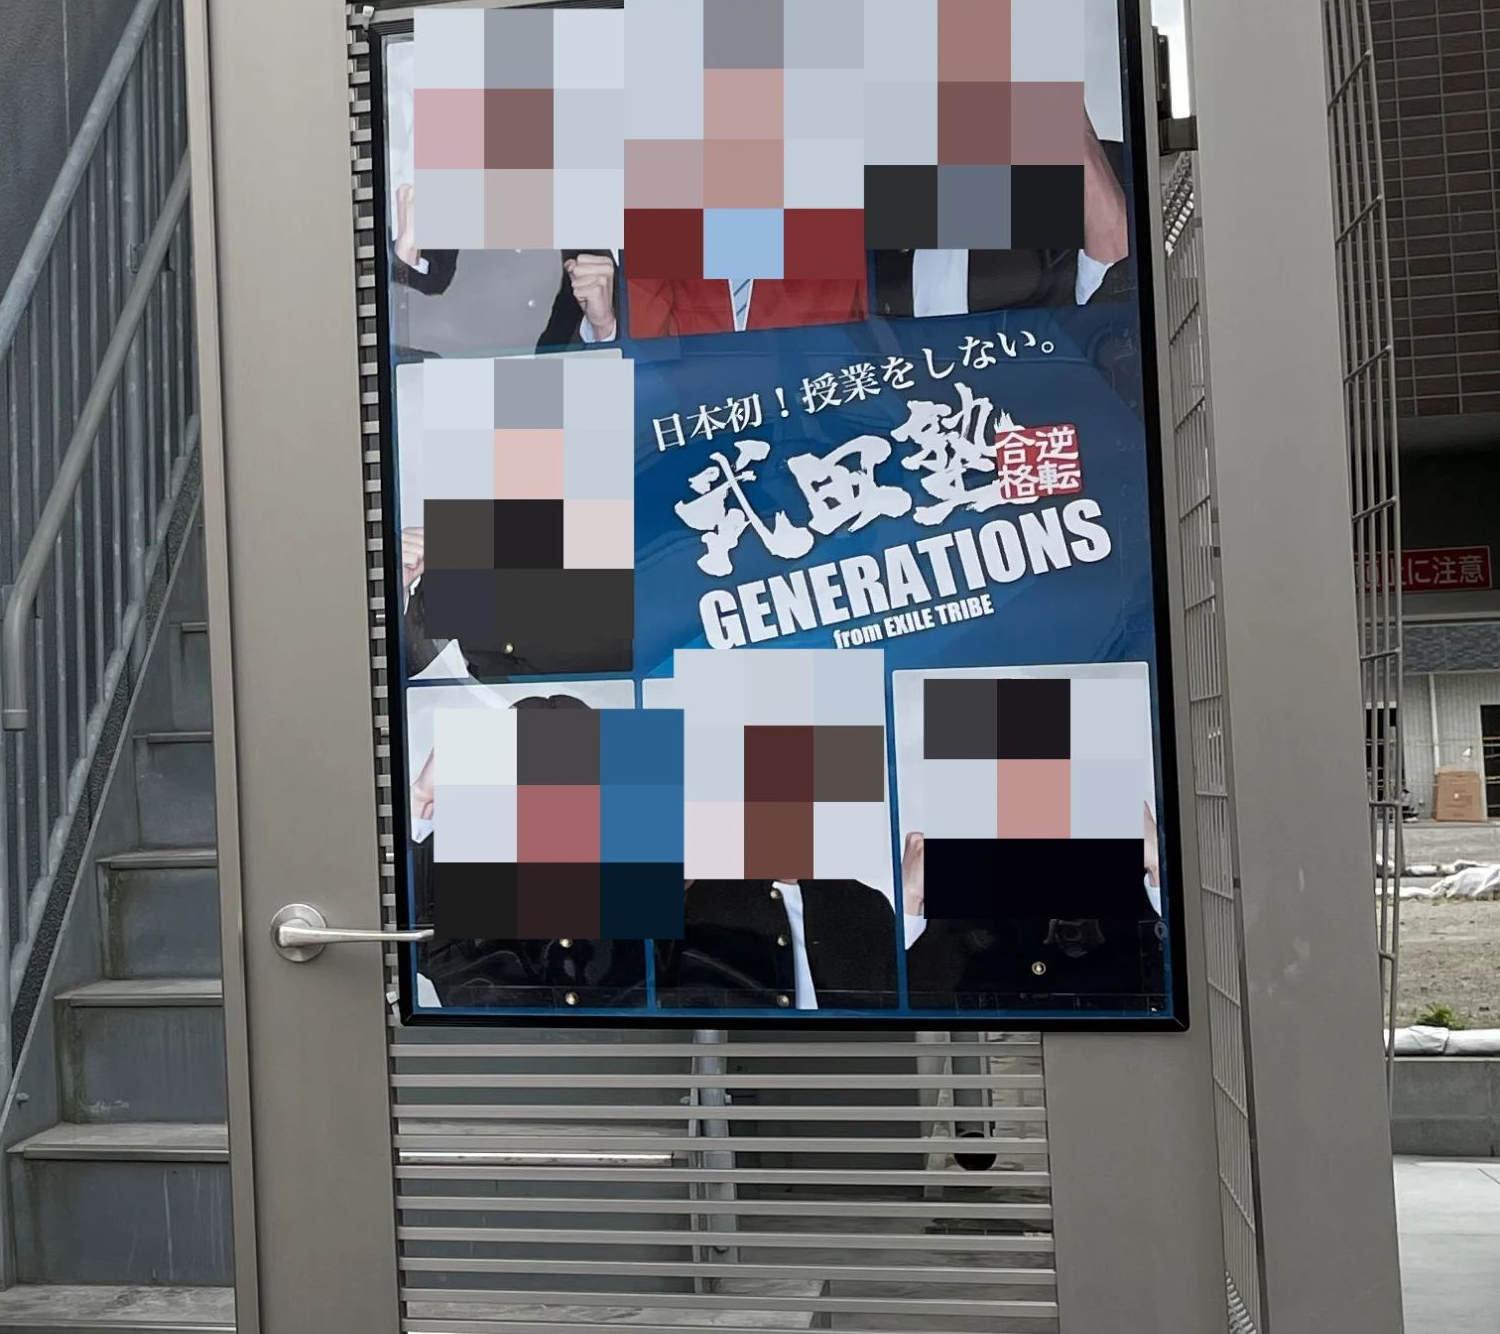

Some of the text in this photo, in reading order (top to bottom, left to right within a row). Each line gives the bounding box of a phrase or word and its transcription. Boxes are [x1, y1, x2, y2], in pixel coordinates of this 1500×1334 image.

[652, 329, 1055, 452] 日本初！授業をしない。
[674, 382, 1040, 578] 武田塾
[699, 498, 1112, 650] GENERATIONS
[834, 593, 995, 649] from EXILE TRIBE
